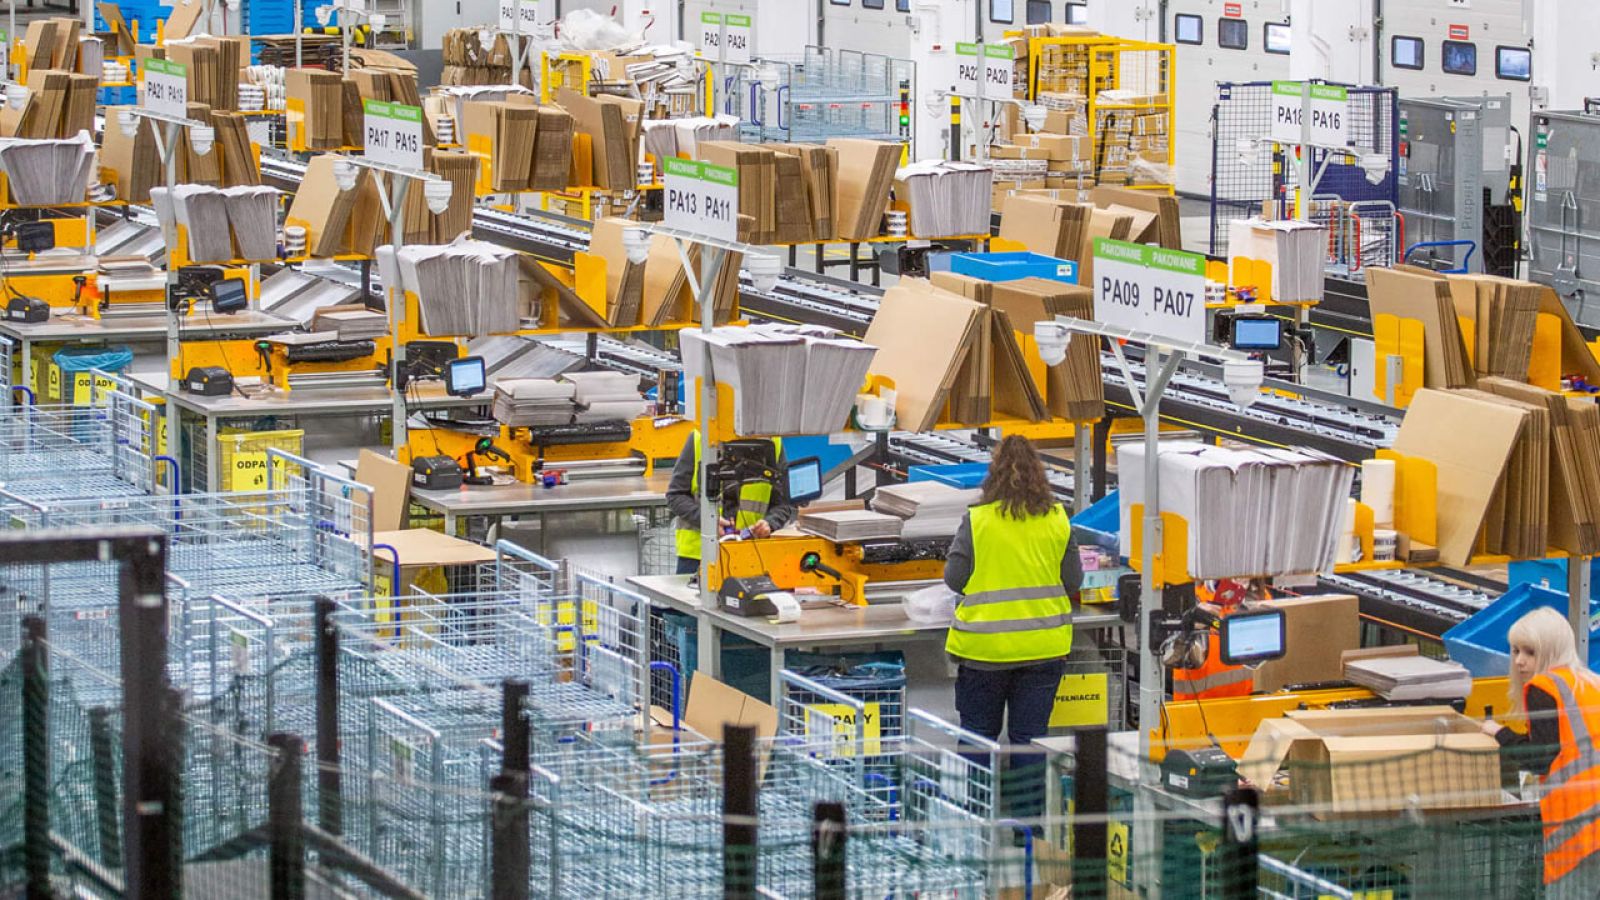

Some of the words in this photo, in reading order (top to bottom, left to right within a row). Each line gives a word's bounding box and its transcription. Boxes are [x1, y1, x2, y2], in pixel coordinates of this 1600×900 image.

[986, 67, 1008, 85] PA20
[1313, 109, 1341, 130] PA16
[368, 127, 389, 148] PA17
[395, 131, 417, 152] PA15
[669, 189, 697, 214] PA13
[705, 196, 730, 222] PA11
[1100, 242, 1142, 261] PAKOWANIE
[1152, 251, 1198, 271] PAKOWANIE
[1102, 276, 1140, 308] PA09
[1153, 286, 1194, 318] PA07
[78, 379, 113, 387] ODADY
[236, 460, 280, 469] ODPAY
